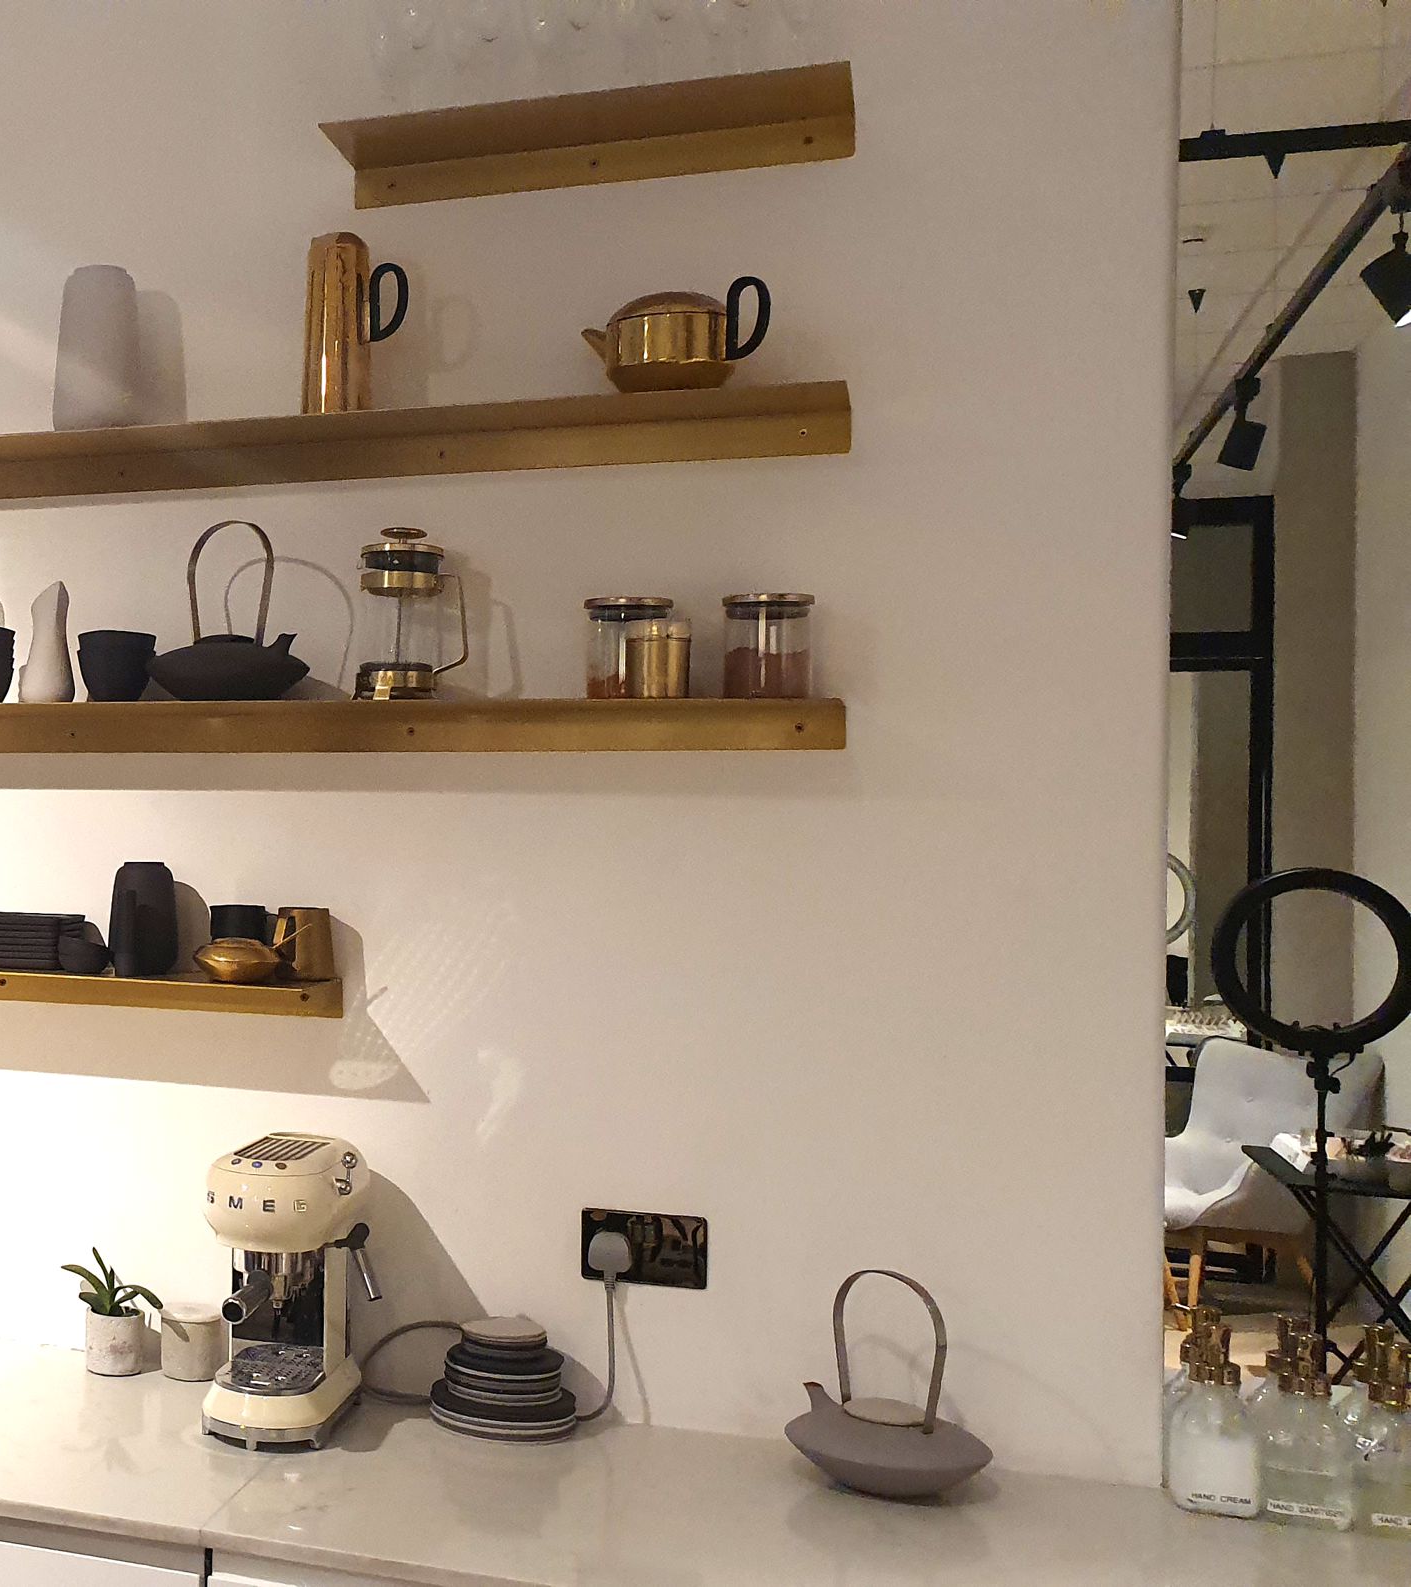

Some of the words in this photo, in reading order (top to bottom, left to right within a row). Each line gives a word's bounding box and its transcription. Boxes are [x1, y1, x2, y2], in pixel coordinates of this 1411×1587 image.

[206, 1190, 307, 1213] SMEG
[1191, 1492, 1216, 1502] HAND
[1219, 1495, 1252, 1505] CREAM
